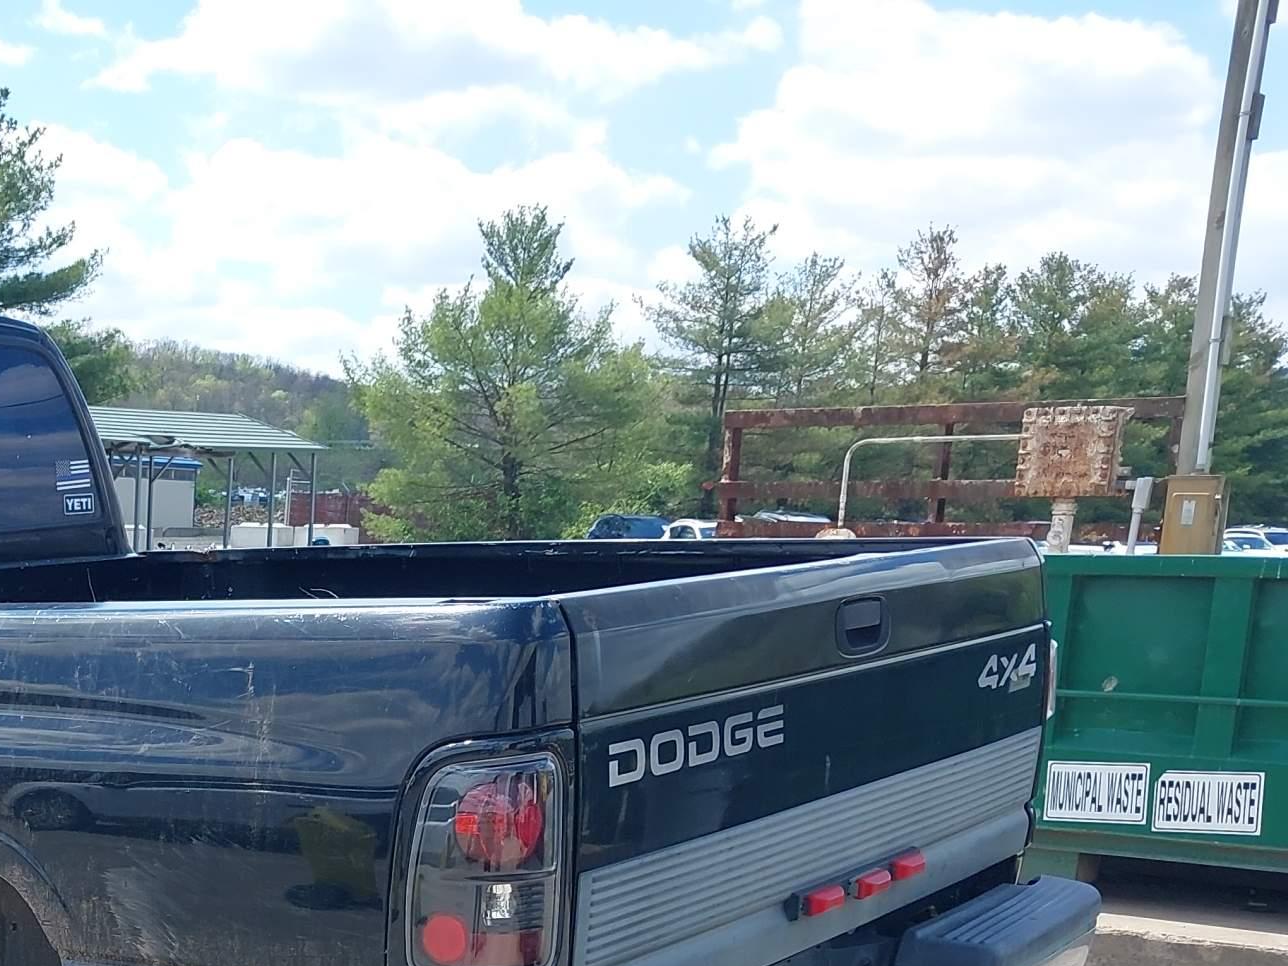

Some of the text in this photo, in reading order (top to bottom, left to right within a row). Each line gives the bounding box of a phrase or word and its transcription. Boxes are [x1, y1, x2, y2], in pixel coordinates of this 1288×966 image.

[66, 497, 91, 511] YETI
[609, 704, 785, 788] DODGE
[1050, 770, 1143, 814] MUNICIPAL WASTE
[1158, 779, 1257, 825] RESIDUAL WASTE
